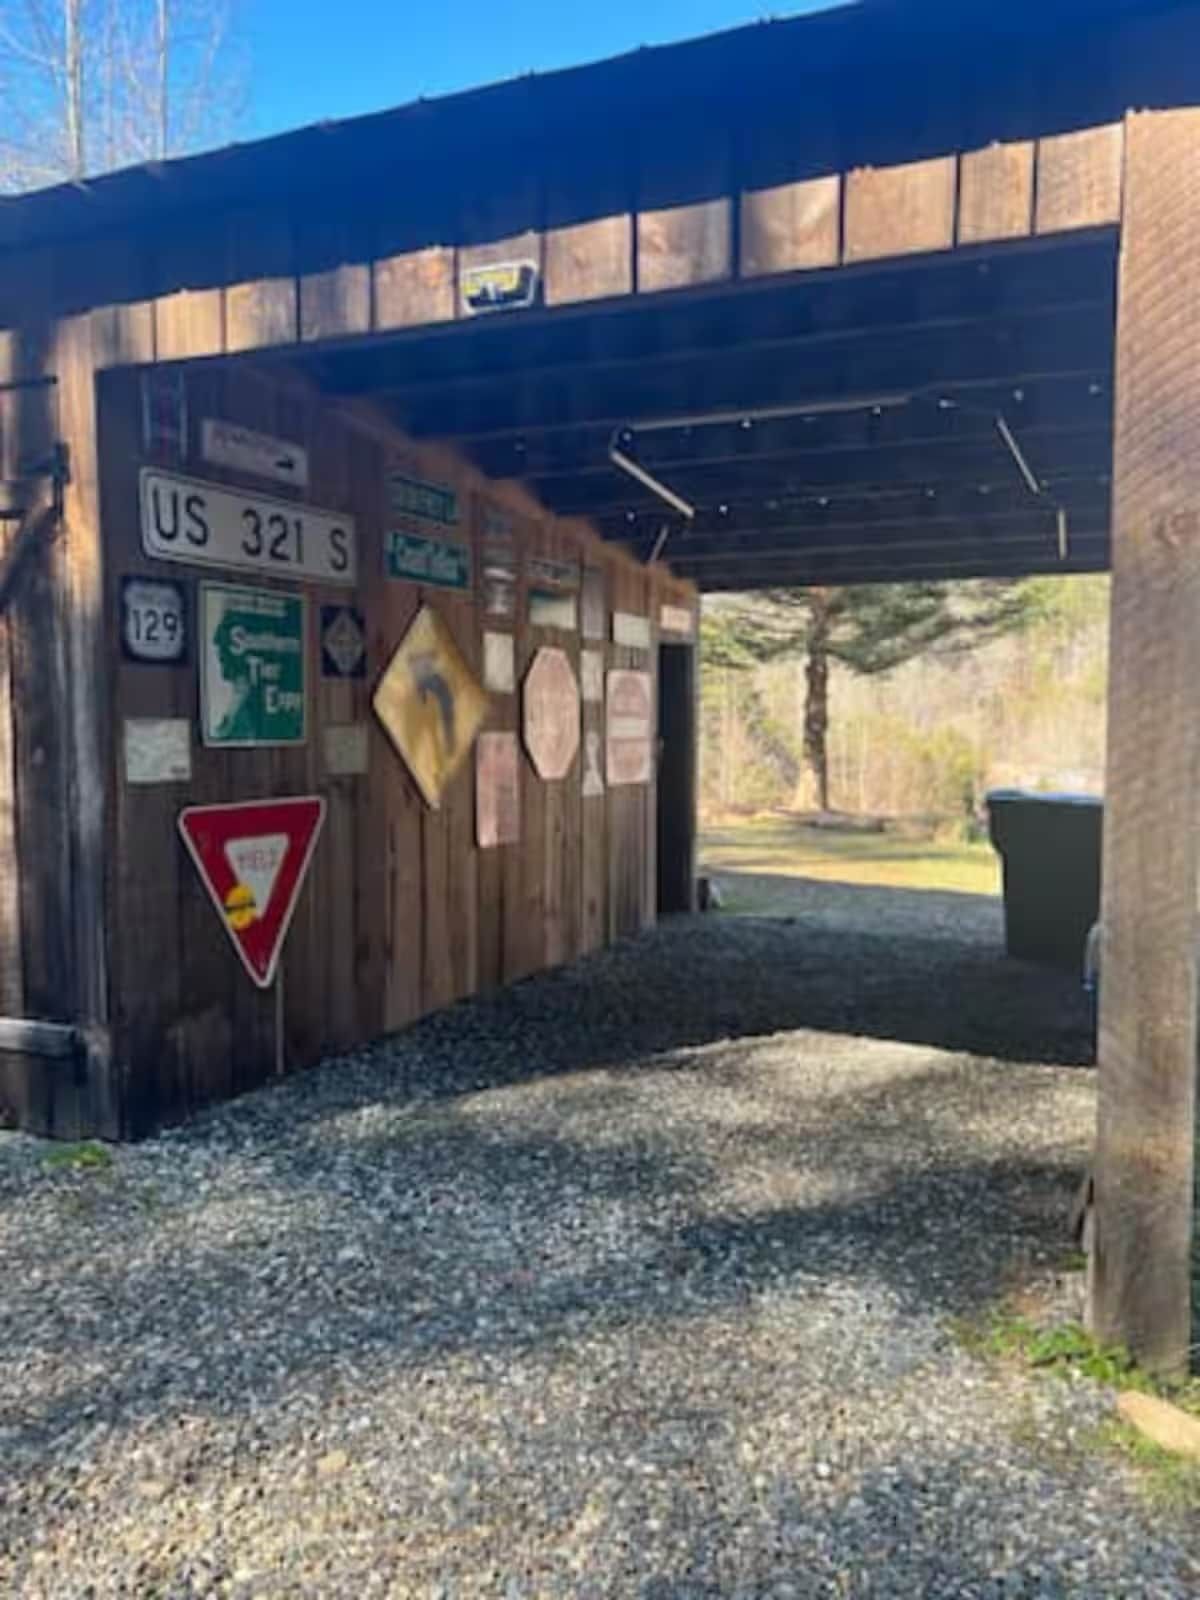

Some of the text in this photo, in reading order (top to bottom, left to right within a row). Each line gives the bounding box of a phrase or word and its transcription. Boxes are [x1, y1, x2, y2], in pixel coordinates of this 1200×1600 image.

[152, 485, 209, 547] US
[241, 508, 304, 565] 321
[328, 527, 349, 572] S
[132, 608, 178, 641] 129
